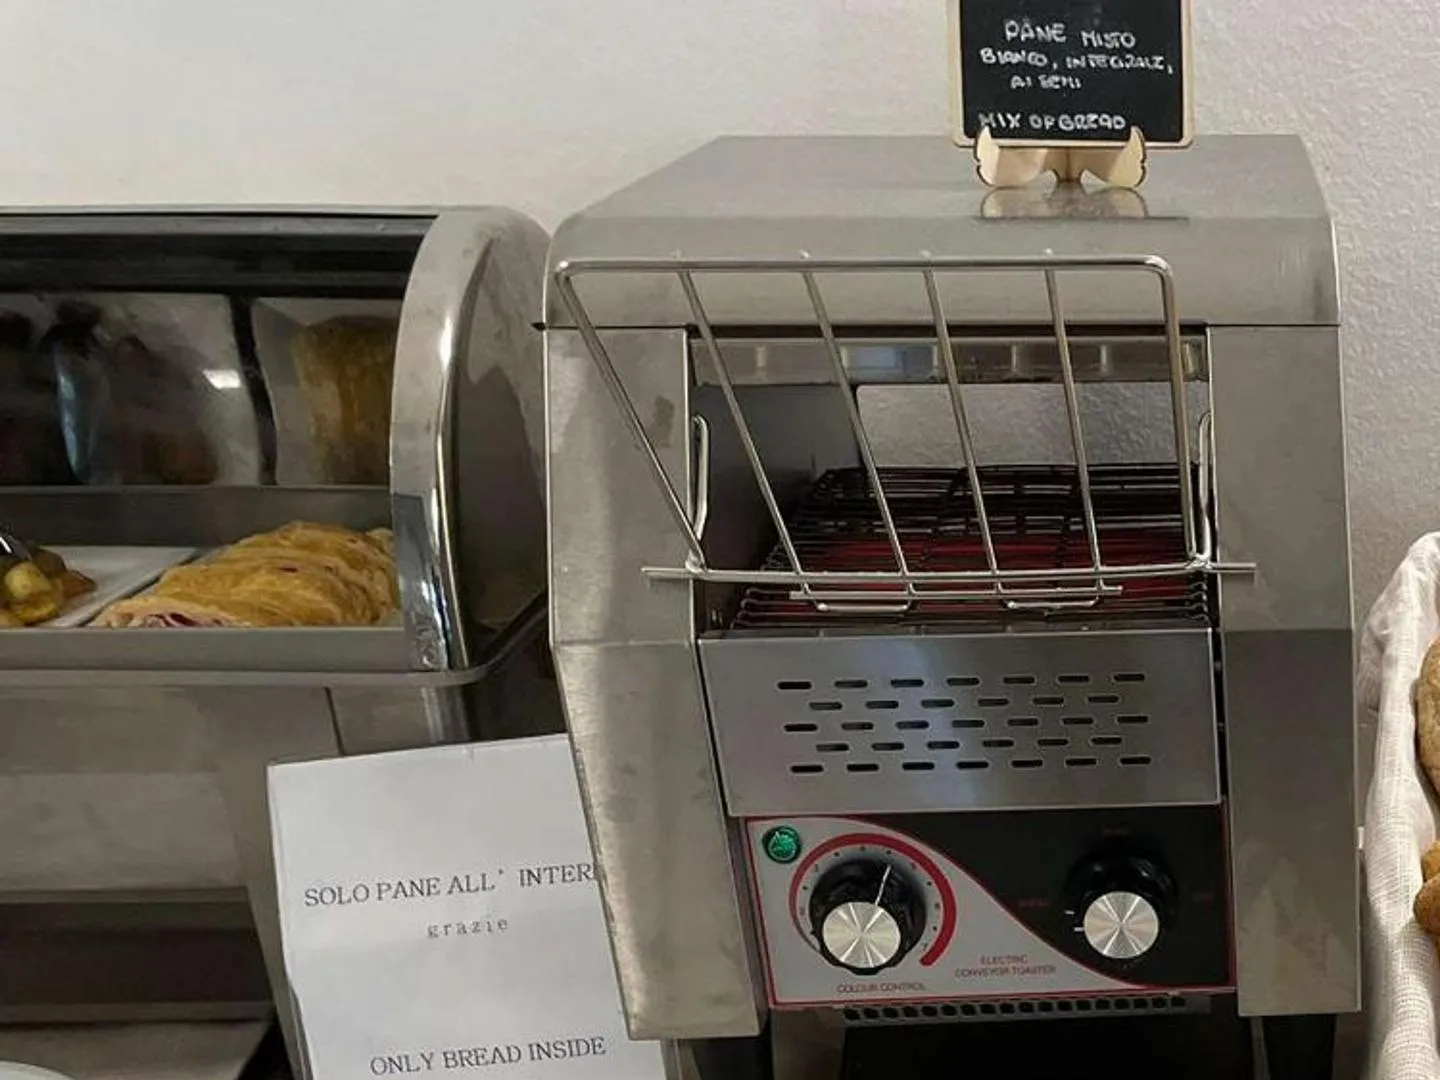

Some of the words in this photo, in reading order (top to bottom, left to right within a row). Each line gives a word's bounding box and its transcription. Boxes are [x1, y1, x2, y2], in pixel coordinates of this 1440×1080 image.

[1004, 18, 1067, 43] PANE
[1080, 30, 1136, 49] MISTO
[978, 112, 1021, 129] MIX
[1029, 114, 1055, 130] OF
[304, 883, 370, 907] SOLO
[376, 876, 441, 902] PANE
[518, 862, 599, 888] INTER
[427, 917, 509, 939] grazie
[369, 1051, 436, 1076] ONLY
[442, 1043, 522, 1069] BREAD
[528, 1036, 608, 1062] INSIDE
